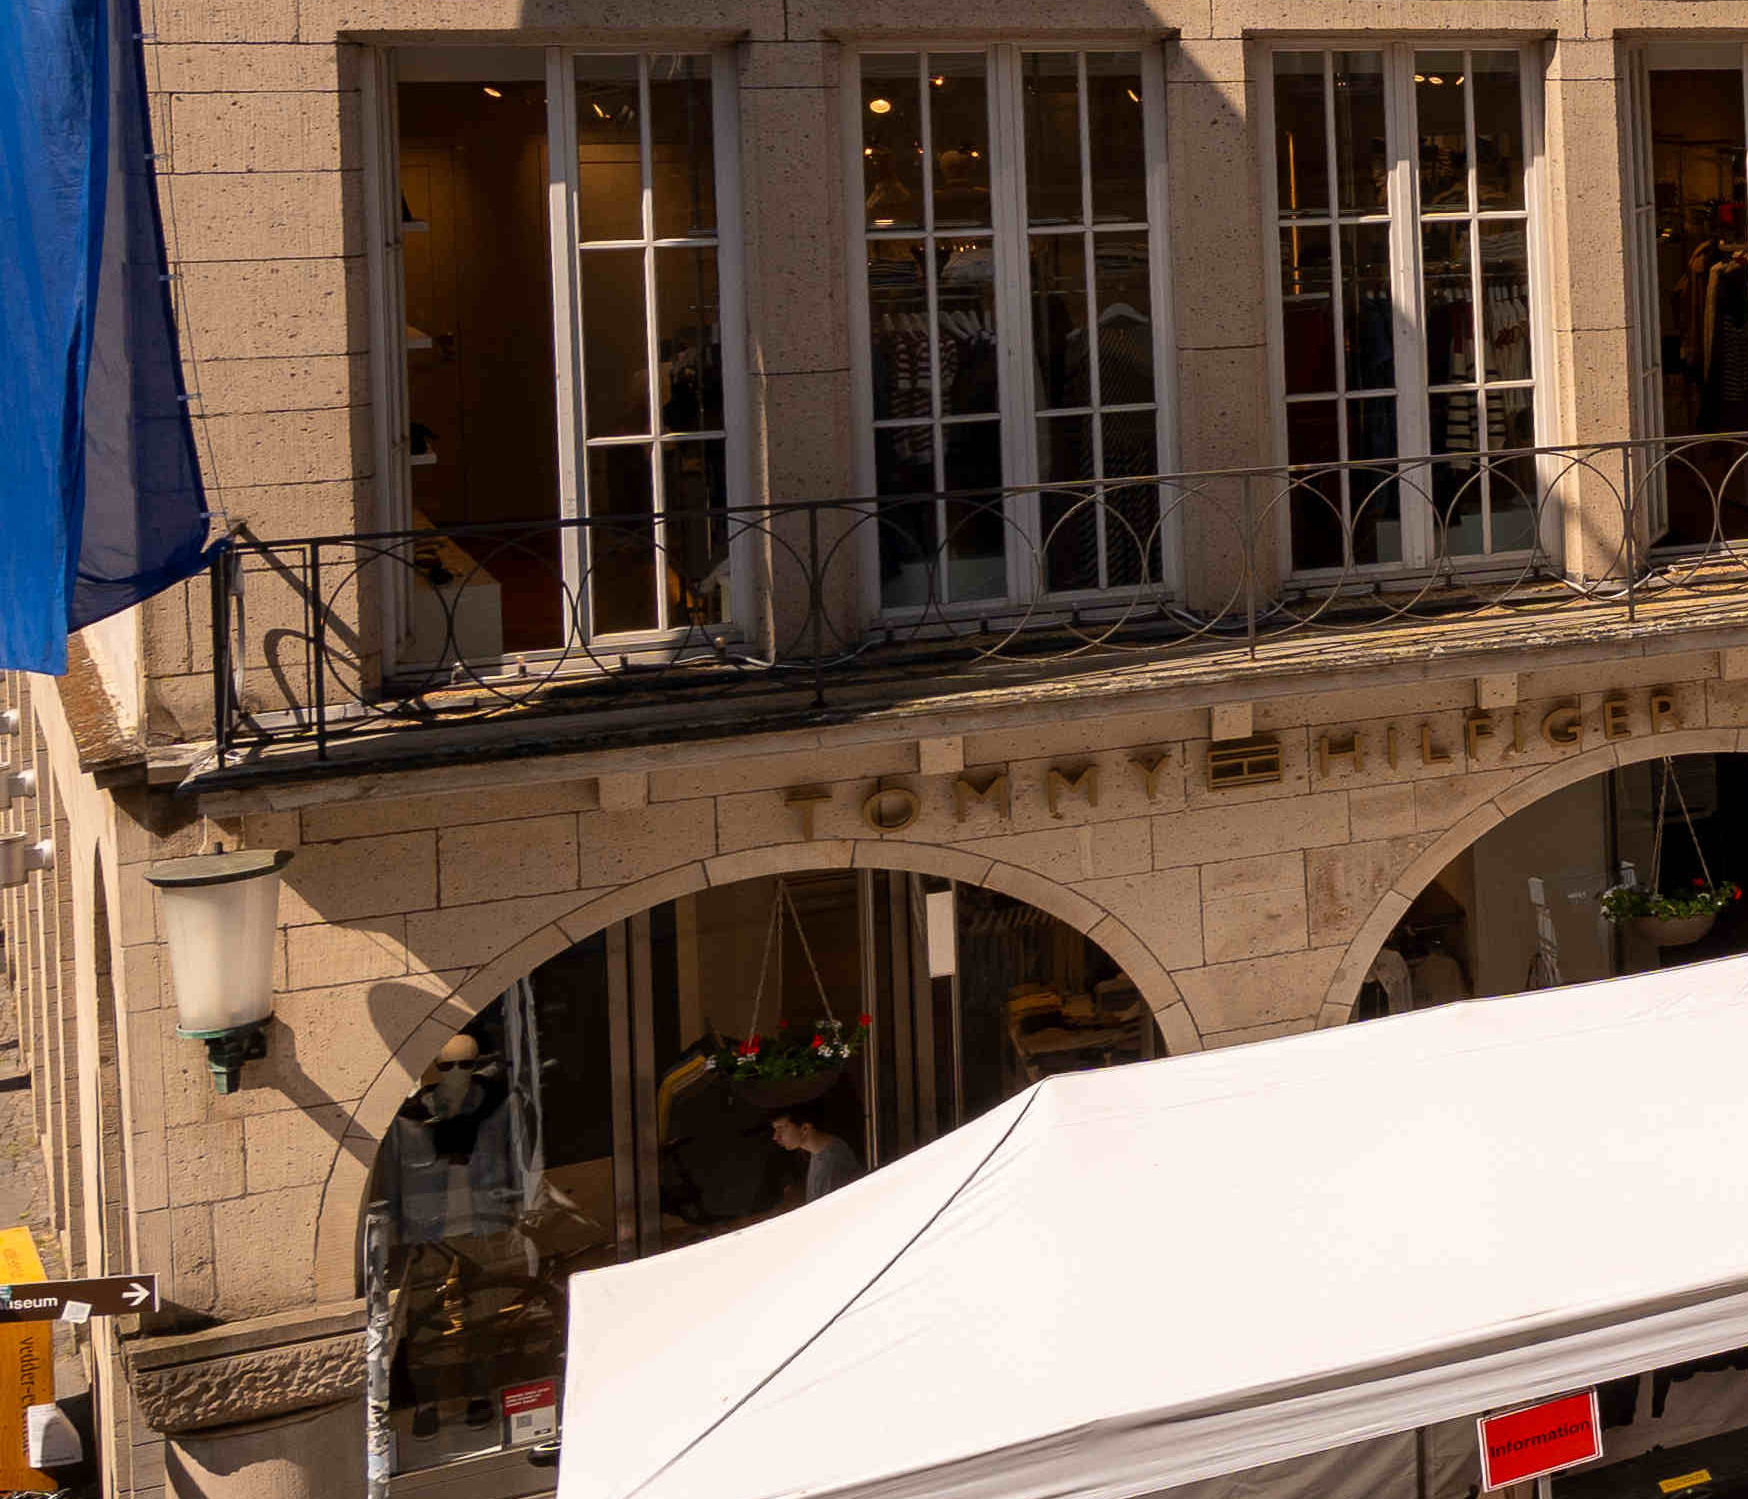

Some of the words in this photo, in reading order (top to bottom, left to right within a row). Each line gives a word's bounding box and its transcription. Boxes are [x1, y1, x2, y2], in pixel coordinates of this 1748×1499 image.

[783, 750, 1173, 843] TOMMY
[1319, 693, 1684, 779] HILFIGER
[1488, 1418, 1592, 1459] Information
